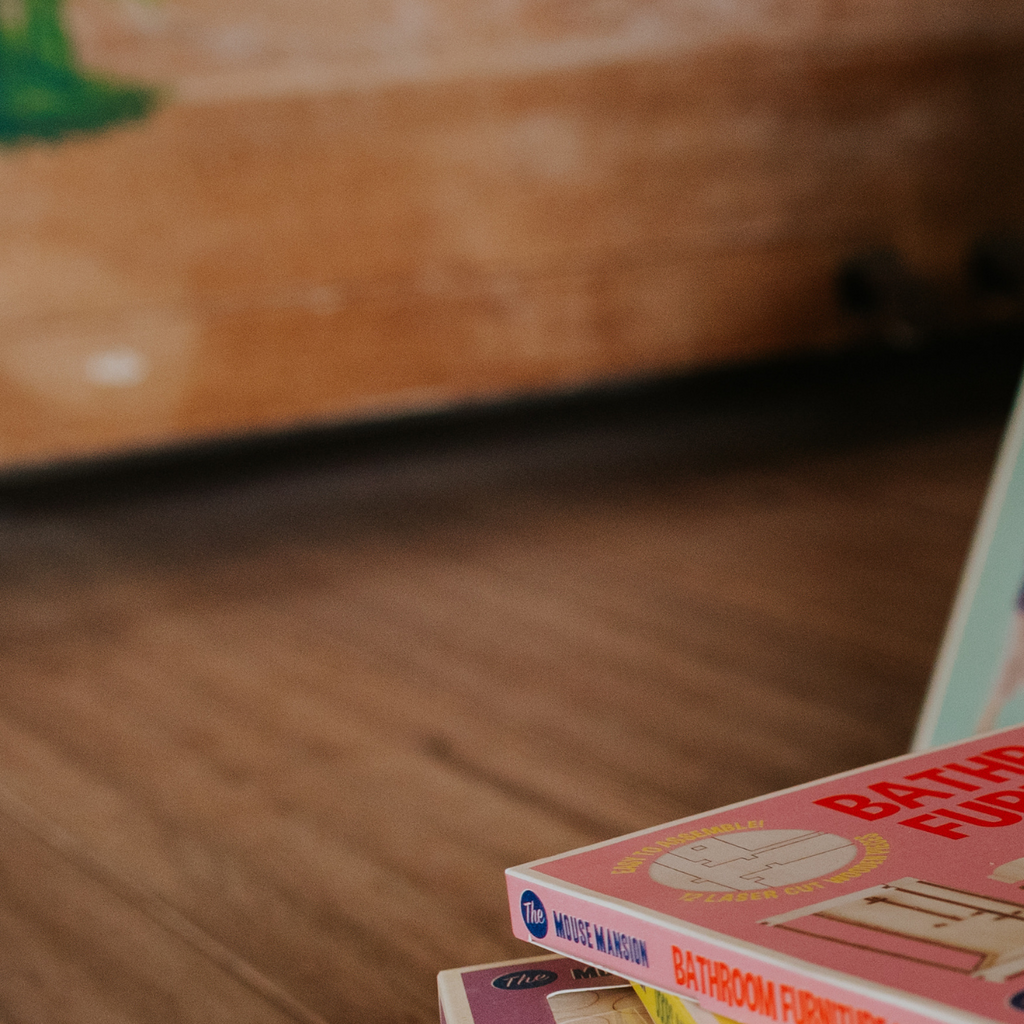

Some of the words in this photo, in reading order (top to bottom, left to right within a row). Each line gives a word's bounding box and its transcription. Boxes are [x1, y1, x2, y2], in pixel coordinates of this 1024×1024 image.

[655, 820, 764, 849] ASSEMBLE!
[704, 890, 778, 903] LASER
[784, 881, 825, 895] CUT
[553, 910, 593, 949] MOUSE
[594, 921, 649, 968] MANSION
[672, 945, 777, 1021] BATHROOM
